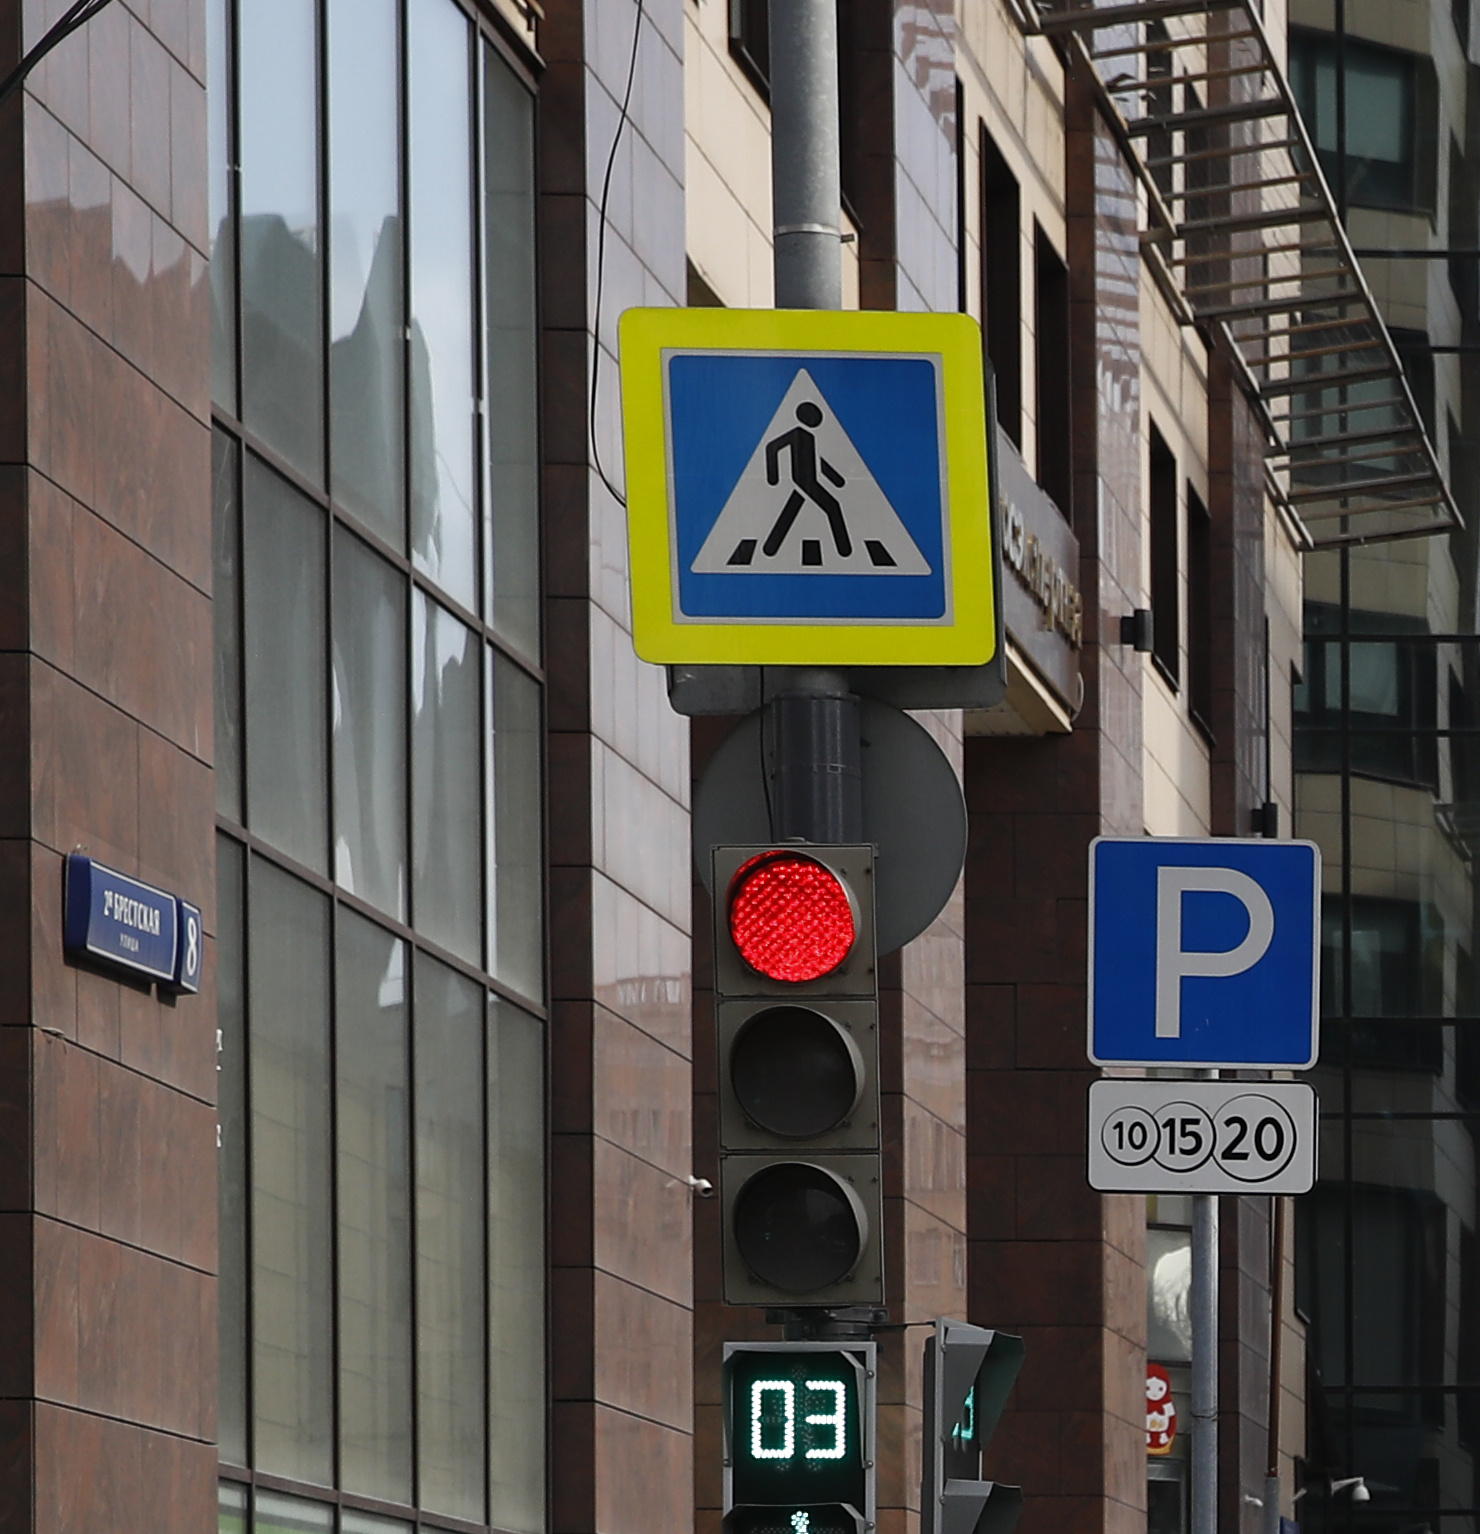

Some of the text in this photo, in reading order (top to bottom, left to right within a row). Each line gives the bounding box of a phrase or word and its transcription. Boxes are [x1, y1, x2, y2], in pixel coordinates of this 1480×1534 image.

[114, 893, 160, 936] БРЕСТСКАЯ
[187, 917, 197, 976] 8
[1155, 866, 1275, 1038] P
[1112, 1116, 1284, 1161] 10 15 20
[751, 1380, 846, 1459] 03
